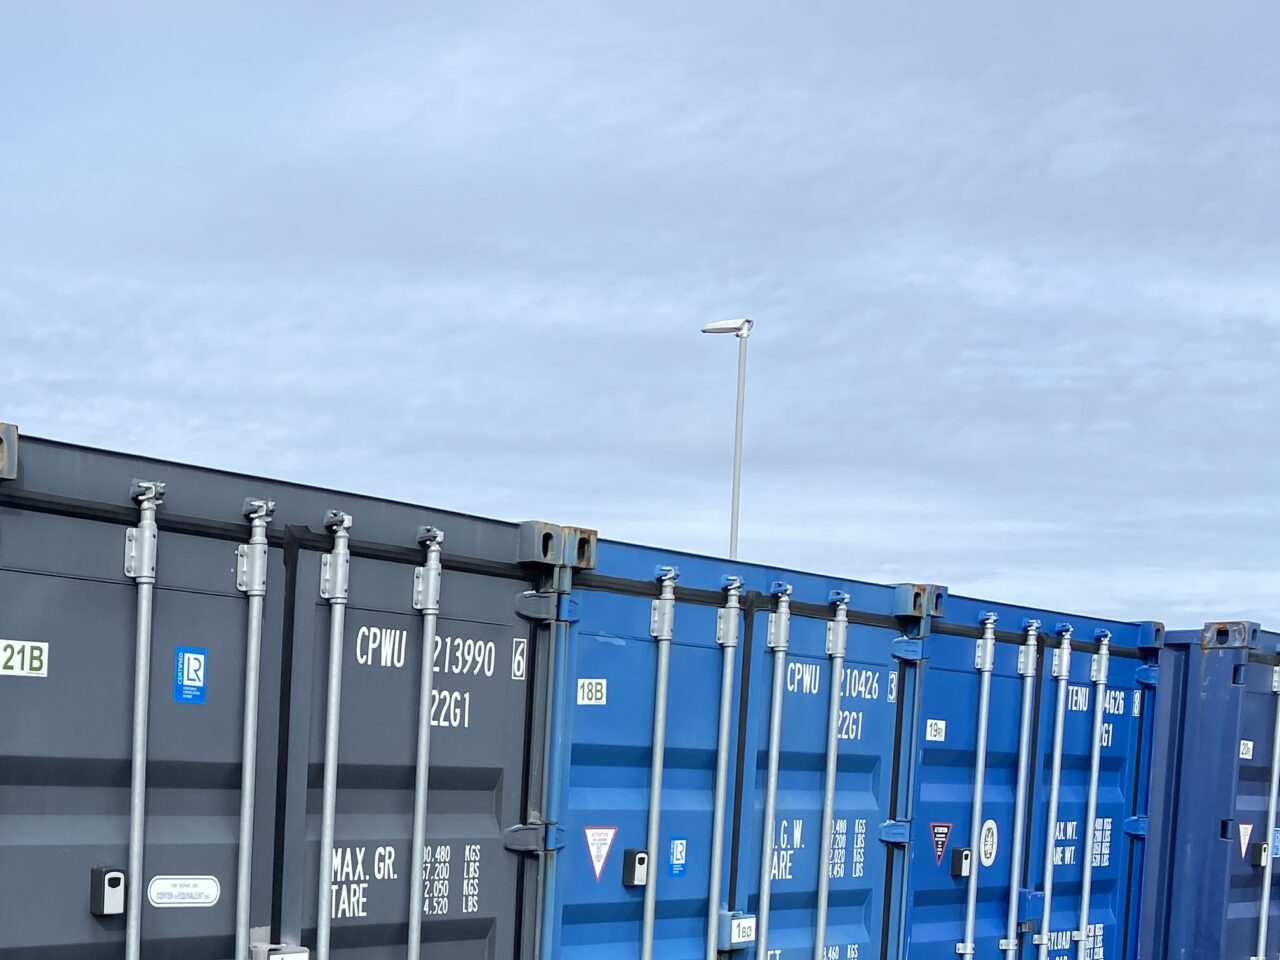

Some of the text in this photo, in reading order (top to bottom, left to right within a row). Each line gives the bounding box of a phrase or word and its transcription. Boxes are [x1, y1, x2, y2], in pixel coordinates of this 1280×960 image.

[2, 643, 44, 672] 21B
[356, 626, 407, 668] CPWU
[432, 635, 496, 677] 213990
[187, 656, 202, 683] LR
[786, 662, 820, 694] CPWU
[580, 681, 604, 701] 18B
[430, 689, 470, 728] 22G1
[772, 819, 805, 849] .G.W.
[331, 846, 398, 882] MAX. GR.
[464, 844, 481, 862] KGS
[771, 850, 794, 880] ARE
[463, 862, 480, 879] LBS
[331, 883, 368, 919] TARE
[462, 878, 479, 896] KGS
[462, 896, 478, 913] LBS
